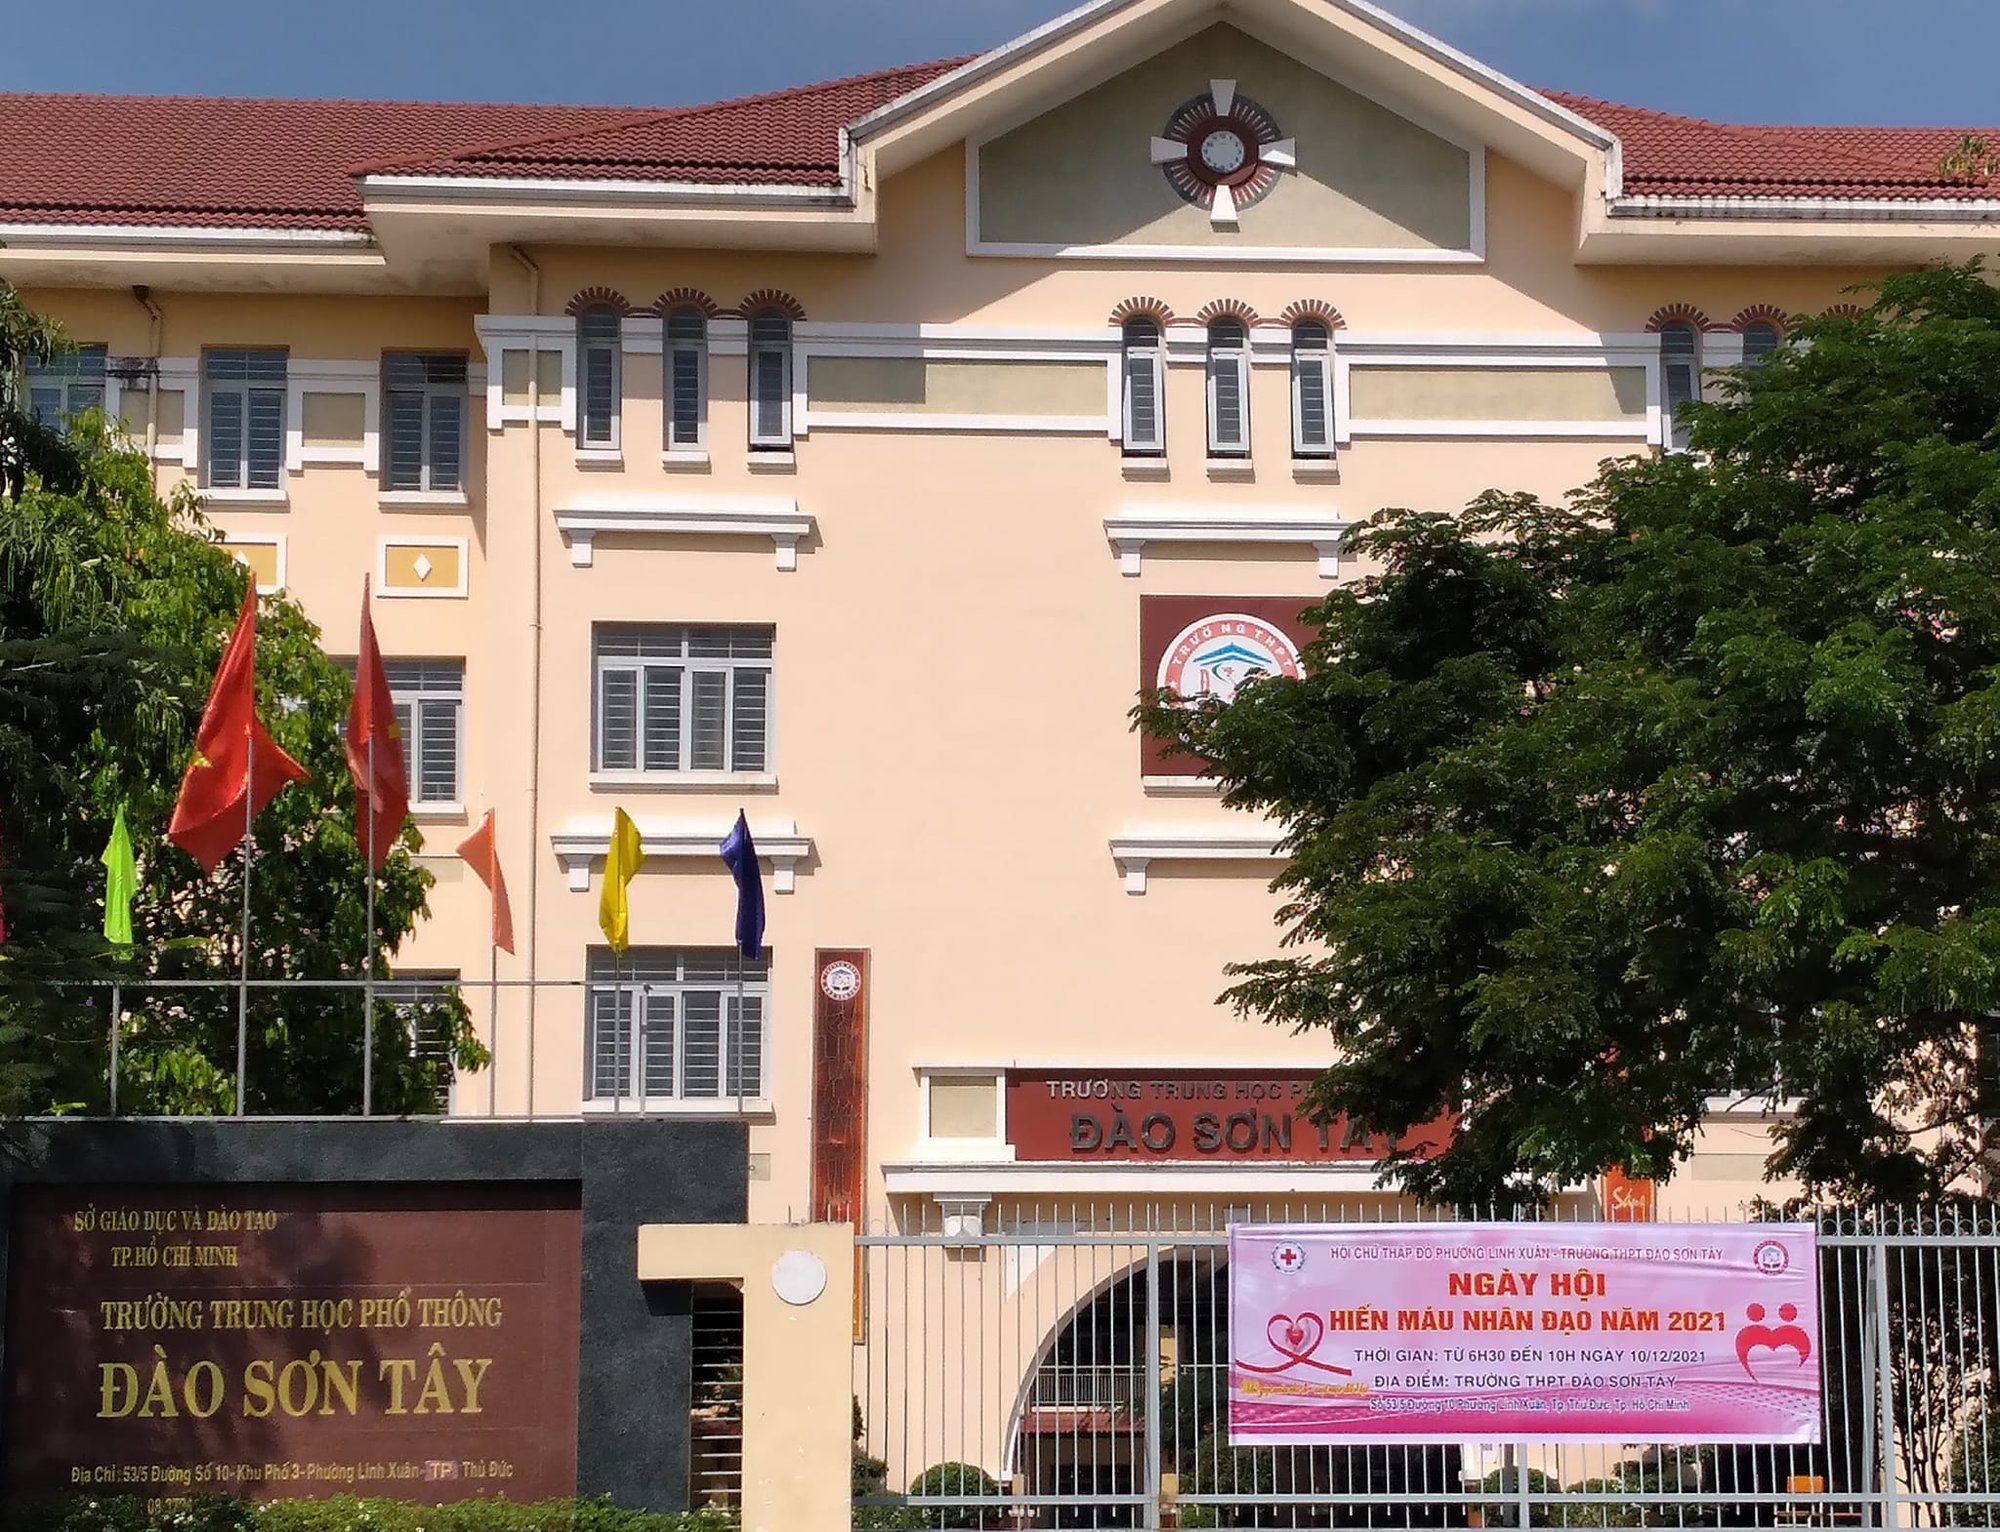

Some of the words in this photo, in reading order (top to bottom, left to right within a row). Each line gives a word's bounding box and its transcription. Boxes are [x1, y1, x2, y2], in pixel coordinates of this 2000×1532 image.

[1254, 627, 1292, 668] THPT
[1151, 1081, 1227, 1099] TRUNG
[1234, 1081, 1282, 1103] HỌC
[1070, 1102, 1176, 1151] ĐÀO
[1192, 1107, 1291, 1151] SƠN
[74, 1202, 96, 1231] SỞ
[100, 1205, 140, 1231] GIÁO
[144, 1210, 177, 1235] DỤC
[181, 1204, 201, 1231] VÀ
[206, 1204, 241, 1231] ĐÀO
[243, 1210, 278, 1235] TẠO
[163, 1240, 191, 1267] CHÍ
[194, 1246, 238, 1267] MINH
[1488, 1247, 1515, 1259] LINH
[1613, 1248, 1642, 1260] THPT
[1449, 1268, 1538, 1296] NGÀY
[1551, 1268, 1606, 1301] HỘI
[100, 1291, 203, 1330] TRƯỜNG
[210, 1299, 294, 1329] TRUNG
[301, 1299, 353, 1334] HỌC
[359, 1286, 411, 1328] PHỔ
[417, 1290, 502, 1328] THÔNG
[1330, 1303, 1388, 1331] HIẾN
[1398, 1305, 1453, 1331] MÁU
[1463, 1306, 1533, 1331] NHÂN
[1542, 1310, 1592, 1335] ĐẠO
[1601, 1306, 1659, 1331] NĂM
[1668, 1311, 1724, 1331] 2021
[1354, 1346, 1390, 1362] THỜI
[1396, 1349, 1438, 1362] GIAN:
[1444, 1346, 1465, 1362] TỪ
[1469, 1349, 1505, 1362] 6H30
[1511, 1345, 1542, 1362] ĐẾN
[1549, 1350, 1575, 1362] 10H
[1581, 1347, 1624, 1362] NGÀY
[1630, 1350, 1705, 1362] 10/12/2021
[96, 1344, 224, 1418] ĐÀO
[243, 1349, 363, 1417] SƠN
[378, 1342, 493, 1415] TÂY
[1375, 1376, 1400, 1390] ĐỊA
[1406, 1369, 1449, 1387] ĐIỂM:
[1455, 1372, 1520, 1387] TRƯỜNG
[1526, 1375, 1566, 1388] THPT
[1571, 1373, 1604, 1388] ĐÀO
[1609, 1374, 1640, 1388] SƠN
[151, 1464, 191, 1485] Đường
[195, 1462, 213, 1481] Số
[357, 1462, 384, 1480] Linh
[431, 1464, 451, 1479] TP
[462, 1460, 486, 1478] Thủ
[489, 1461, 513, 1478] Đức
